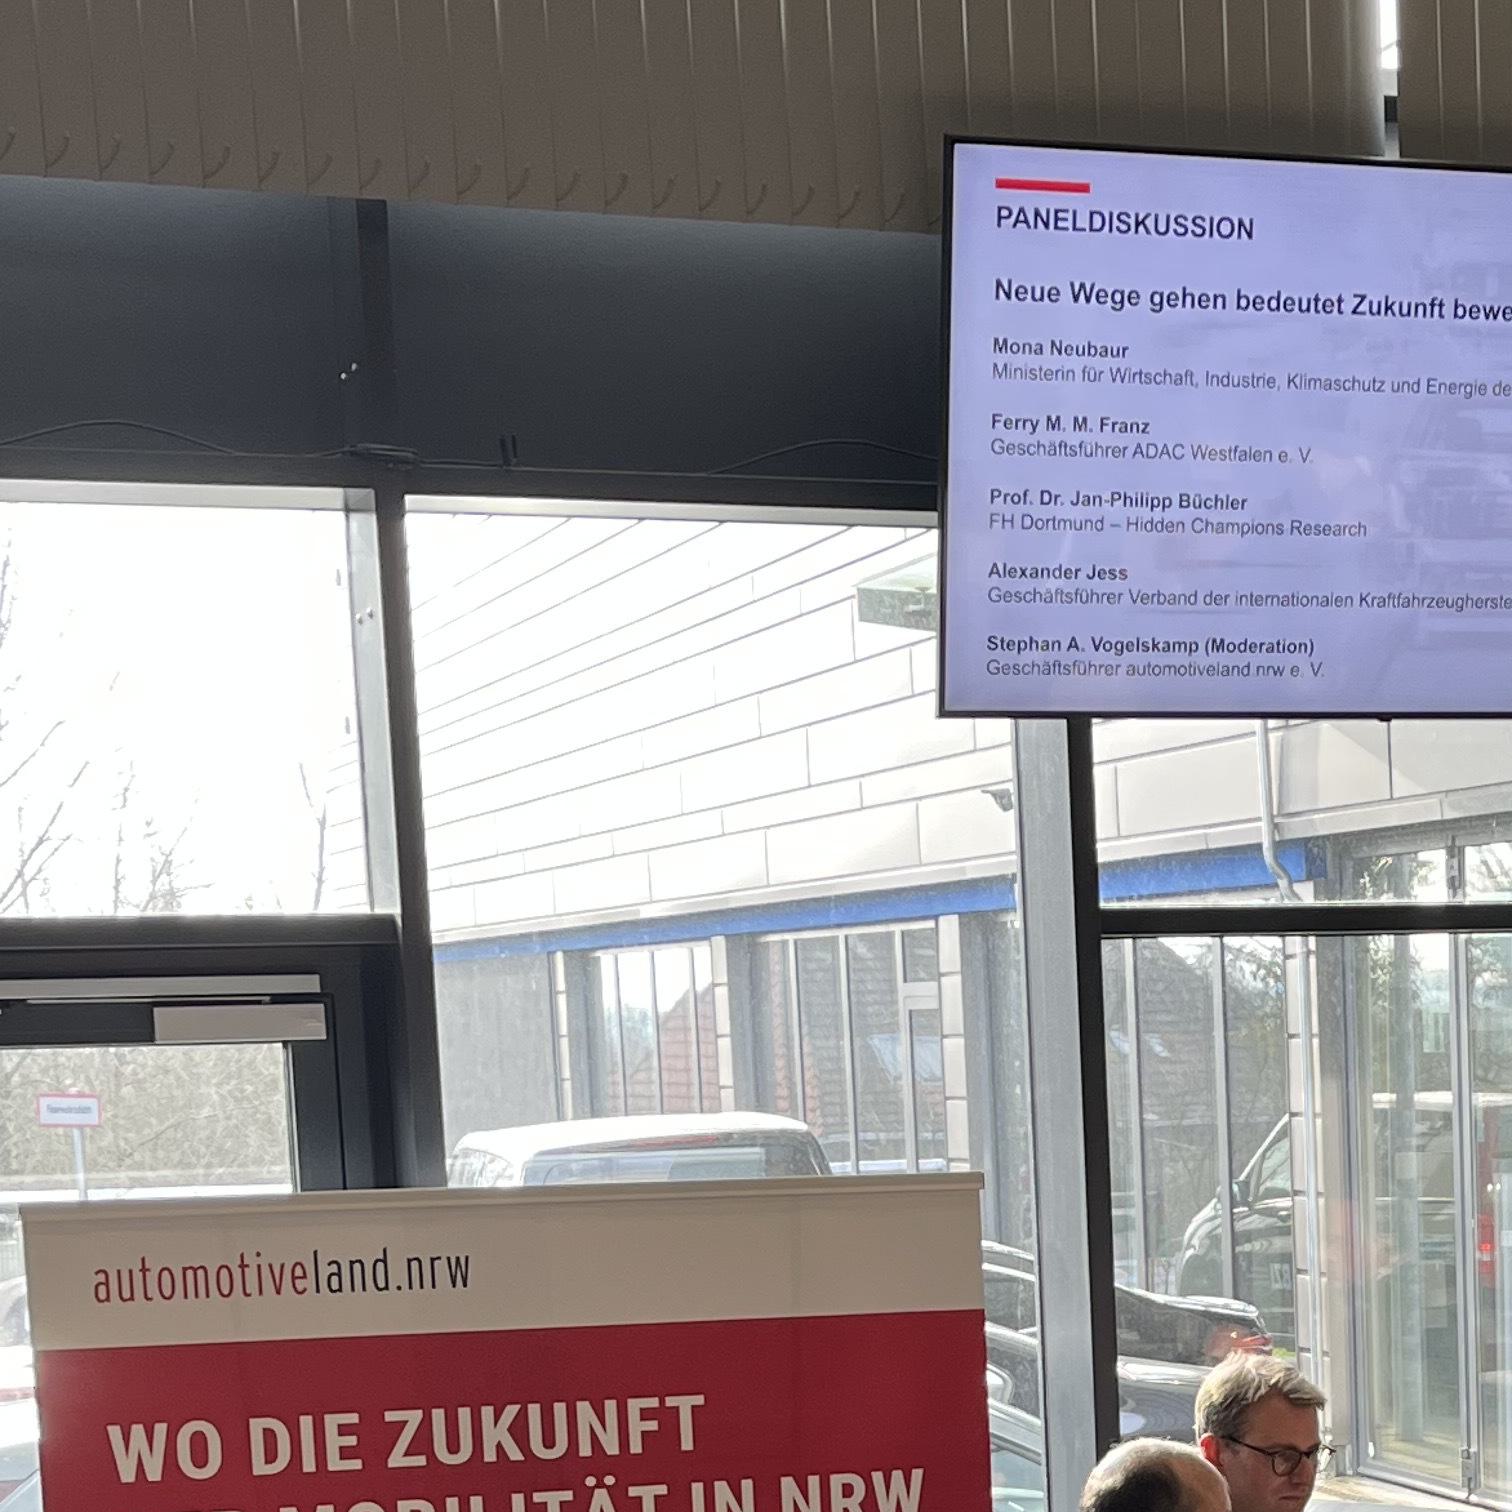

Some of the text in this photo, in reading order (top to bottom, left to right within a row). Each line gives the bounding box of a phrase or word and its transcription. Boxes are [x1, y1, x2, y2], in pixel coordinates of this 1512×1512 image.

[996, 206, 1254, 239] PANELDISKUSSION
[995, 278, 1061, 303] Neue
[1069, 281, 1141, 312] Wege
[1149, 286, 1227, 313] gehen
[1236, 288, 1344, 315] bedeutet
[1351, 294, 1446, 319] Zukunft
[993, 338, 1129, 359] Mona Neubaur
[992, 363, 1076, 383] Ministerin
[1081, 365, 1103, 384] für
[1108, 366, 1199, 388] Wirtschaft,
[1205, 371, 1281, 391] Industrie,
[1287, 373, 1386, 393] Klimaschutz
[1391, 378, 1420, 394] und
[1426, 379, 1487, 398] Energie
[991, 413, 1150, 435] Ferry M. M. Franz
[990, 438, 1127, 460] Geschäftsführer
[1132, 442, 1185, 460] ADAC
[1190, 444, 1273, 462] Westfalen
[990, 489, 1248, 512] Prof. Dr. Jan-Philipp Büchler
[988, 513, 1015, 530] FH
[1021, 513, 1104, 532] Dortmund
[1126, 516, 1185, 534] Hidden
[1190, 517, 1284, 538] Champions
[1290, 519, 1367, 538] Research
[988, 563, 1128, 581] Alexander Jess
[988, 586, 1124, 606] Geschäftsführer
[1129, 588, 1199, 606] Verband
[1203, 589, 1230, 607] der
[1234, 590, 1354, 609] internationalen
[987, 635, 1315, 658] Stephan A. Vogelskamp (Moderation)
[986, 659, 1121, 678] Geschäftsführer
[94, 1248, 471, 1305] automotiveland.nrw
[107, 1394, 705, 1483] WO DIE ZUKUNFT
